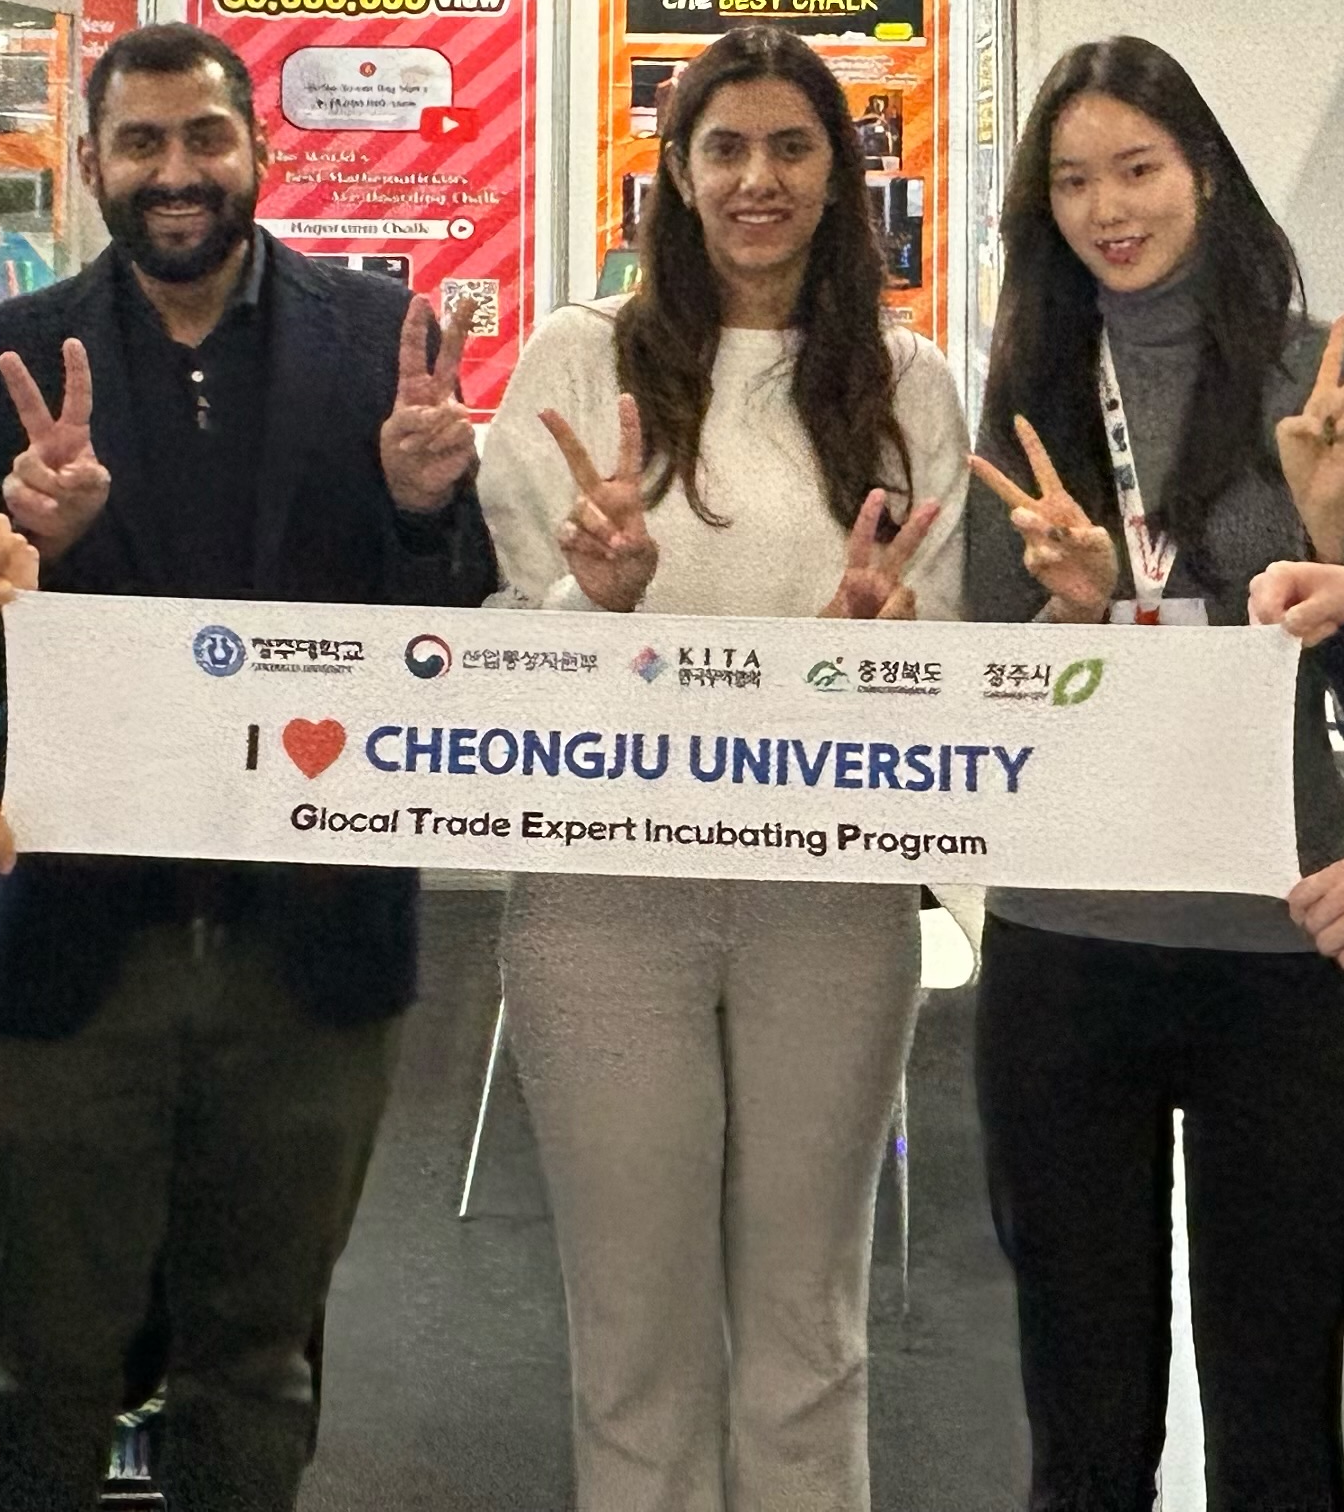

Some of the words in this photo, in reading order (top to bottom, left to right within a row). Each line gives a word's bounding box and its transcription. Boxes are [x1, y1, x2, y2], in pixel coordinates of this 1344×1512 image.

[245, 724, 261, 772] I
[364, 724, 670, 780] CHEONGJU
[688, 734, 1036, 793] UNIVERSITY
[289, 802, 400, 834] Glocal
[406, 806, 511, 838] Trade
[520, 810, 638, 846] Expert
[643, 817, 828, 857] Incubating
[836, 822, 988, 861] Program
